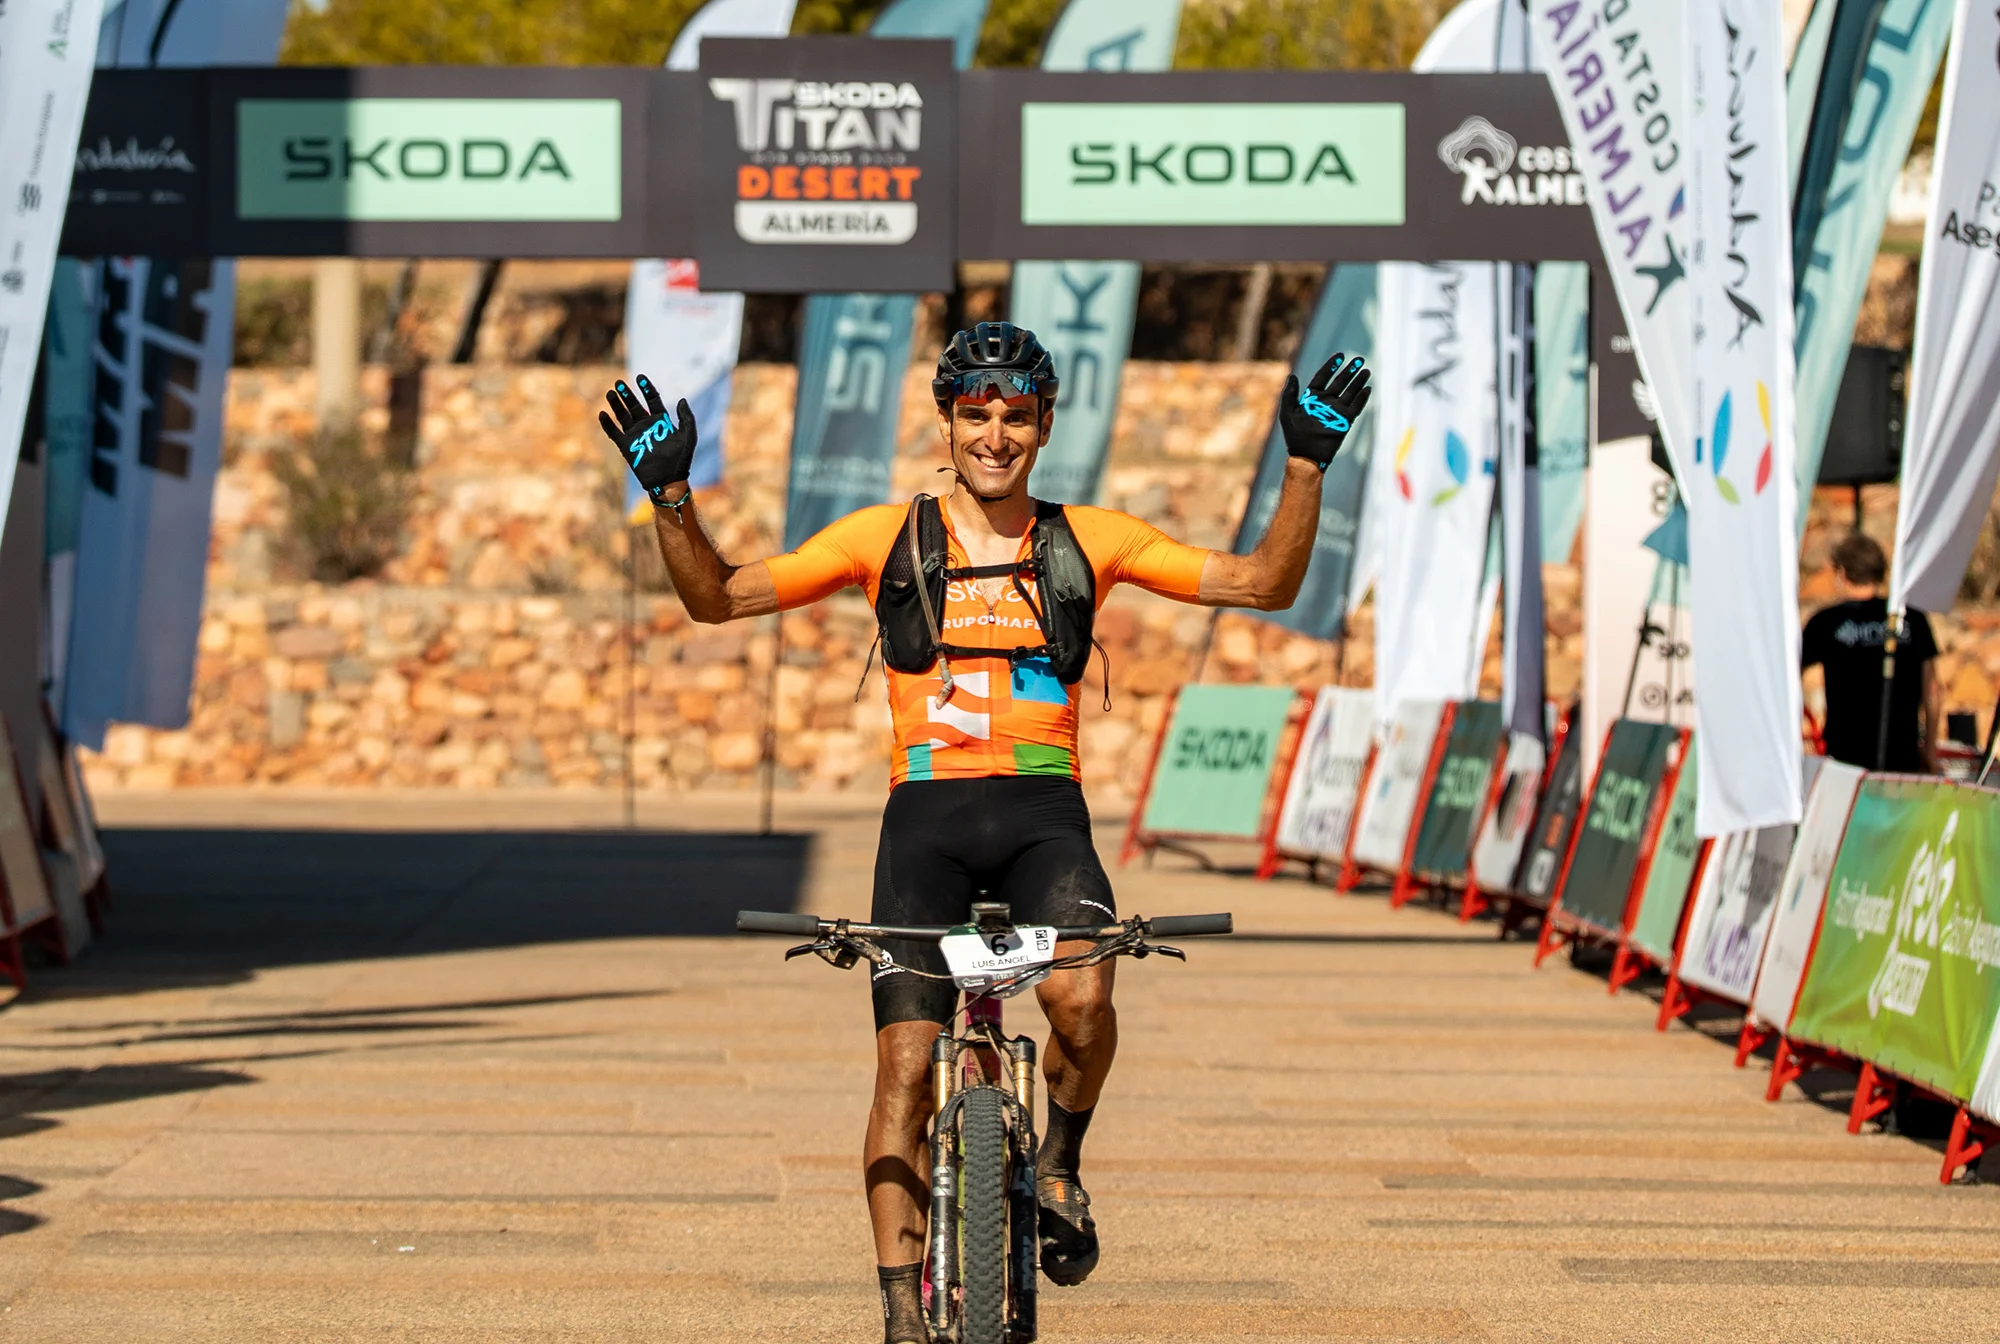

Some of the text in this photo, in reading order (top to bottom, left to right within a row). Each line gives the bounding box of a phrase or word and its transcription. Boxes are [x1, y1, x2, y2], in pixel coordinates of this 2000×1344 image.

[1517, 145, 1583, 173] COS
[737, 166, 921, 201] DESERT
[1494, 173, 1588, 206] ALME
[942, 614, 989, 630] RUPO
[990, 934, 1010, 956] 6
[972, 955, 1032, 969] LUIS ANGEL
